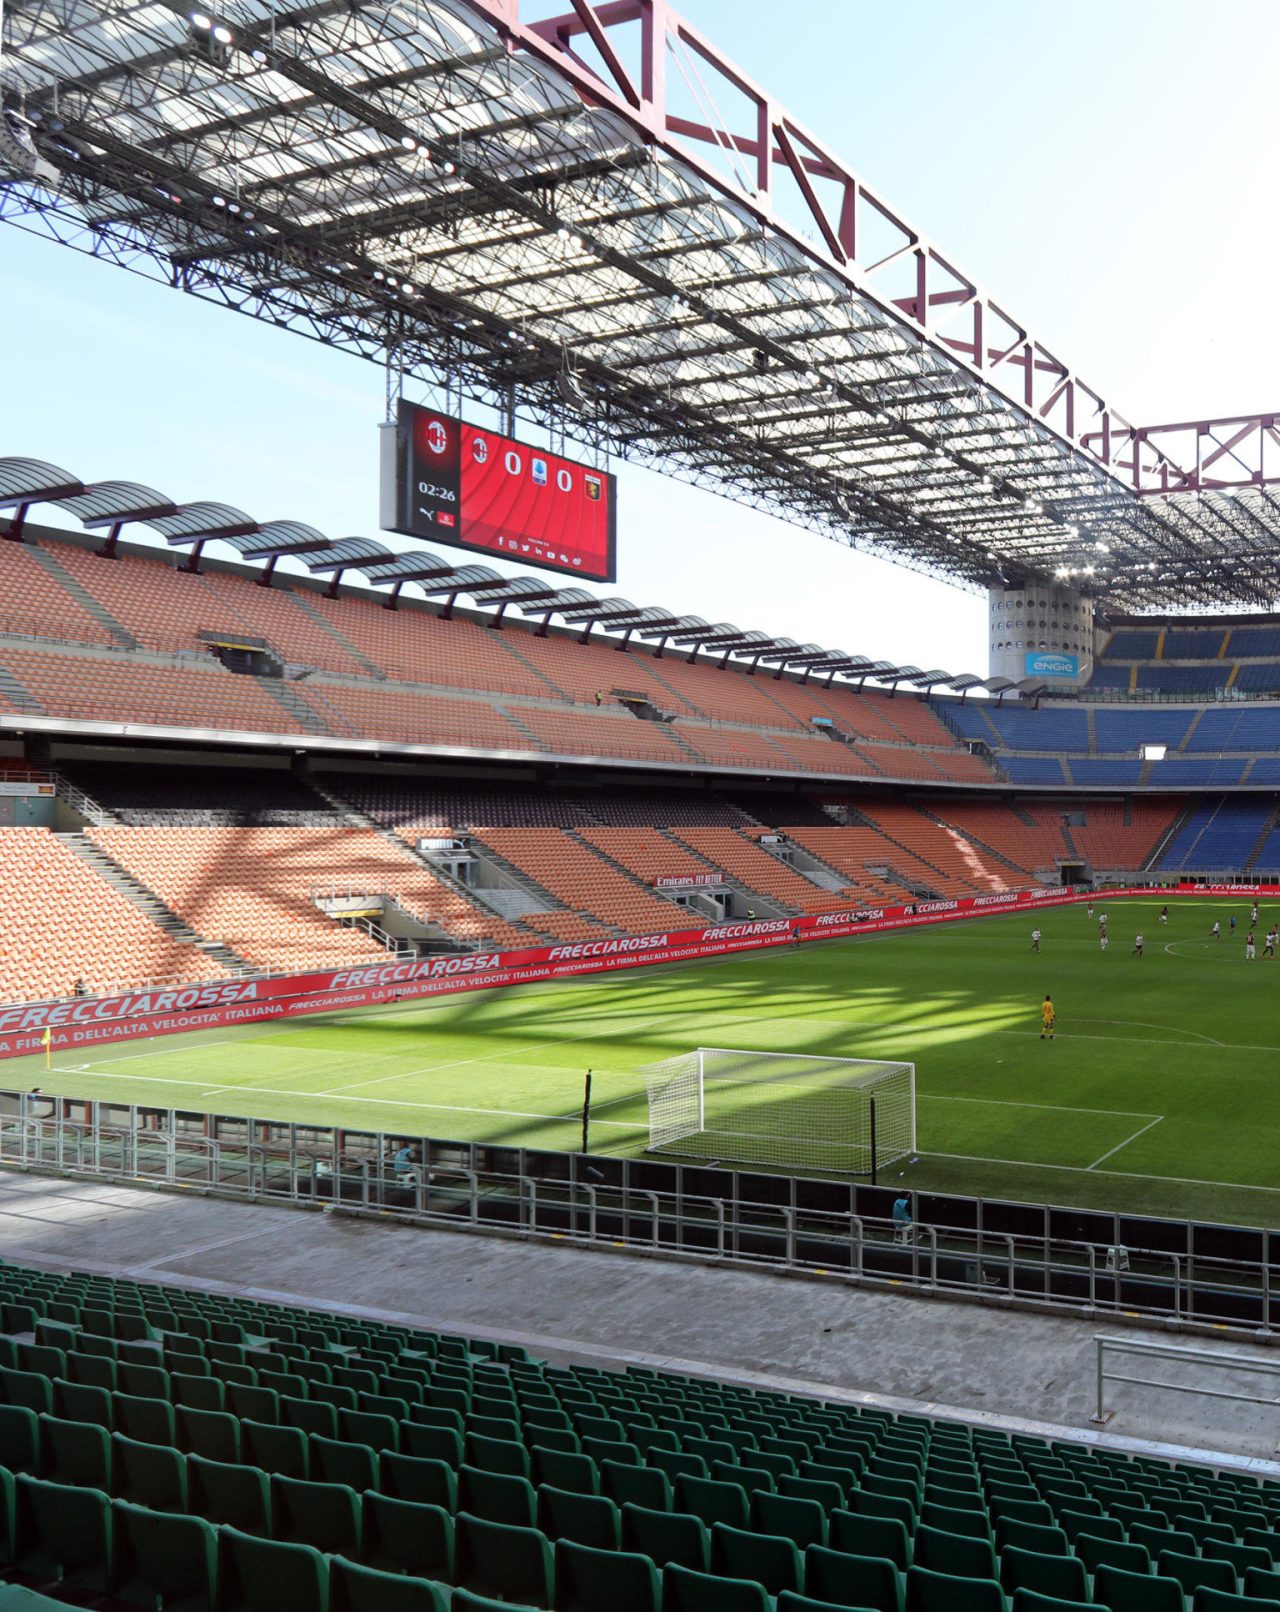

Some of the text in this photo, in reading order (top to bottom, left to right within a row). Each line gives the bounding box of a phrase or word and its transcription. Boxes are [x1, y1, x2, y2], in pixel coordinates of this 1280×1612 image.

[504, 451, 521, 476] 0
[418, 481, 456, 502] 02:26
[556, 469, 573, 492] 0
[656, 876, 694, 886] Emirates
[701, 919, 790, 941] FRECCIAROSSA
[548, 934, 668, 961] FRECCIAROSSA
[329, 954, 500, 988] FRECCIAROSSA
[372, 967, 550, 1000] LA FIRMA DELL'ALTA VELOCITA' ITALIANA
[0, 982, 258, 1030] FRECCIAROSSA
[288, 994, 366, 1011] FRECCIAROSSA
[73, 1021, 149, 1042] DELL'ALTA
[152, 1012, 221, 1029] VELOCITA'
[225, 1003, 284, 1020] ITALIANA
